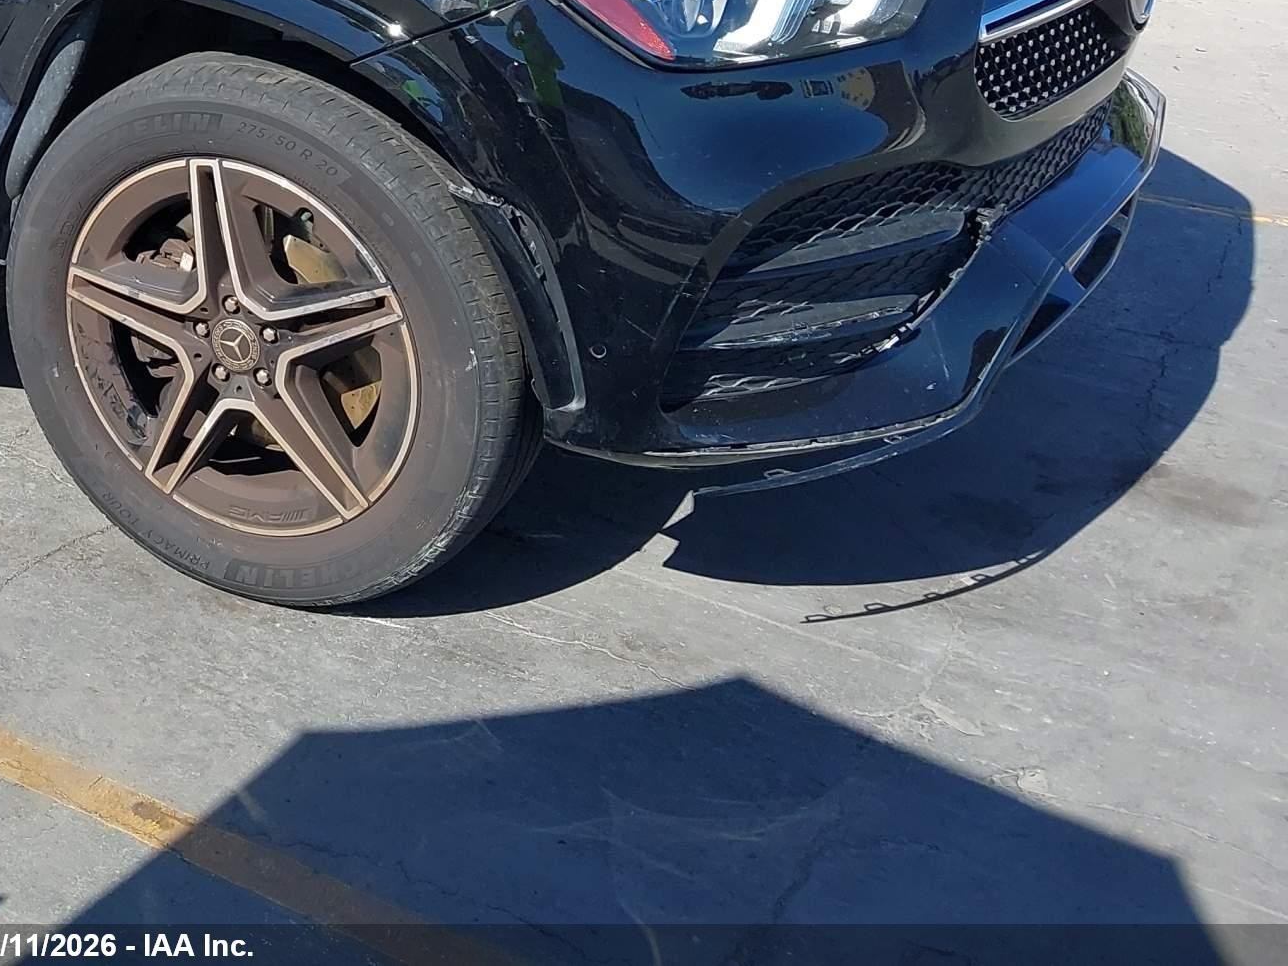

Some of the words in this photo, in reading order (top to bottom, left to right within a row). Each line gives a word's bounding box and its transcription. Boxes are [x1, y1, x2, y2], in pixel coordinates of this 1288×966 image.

[237, 121, 297, 152] 275/50
[299, 148, 313, 161] R
[315, 159, 338, 177] 20
